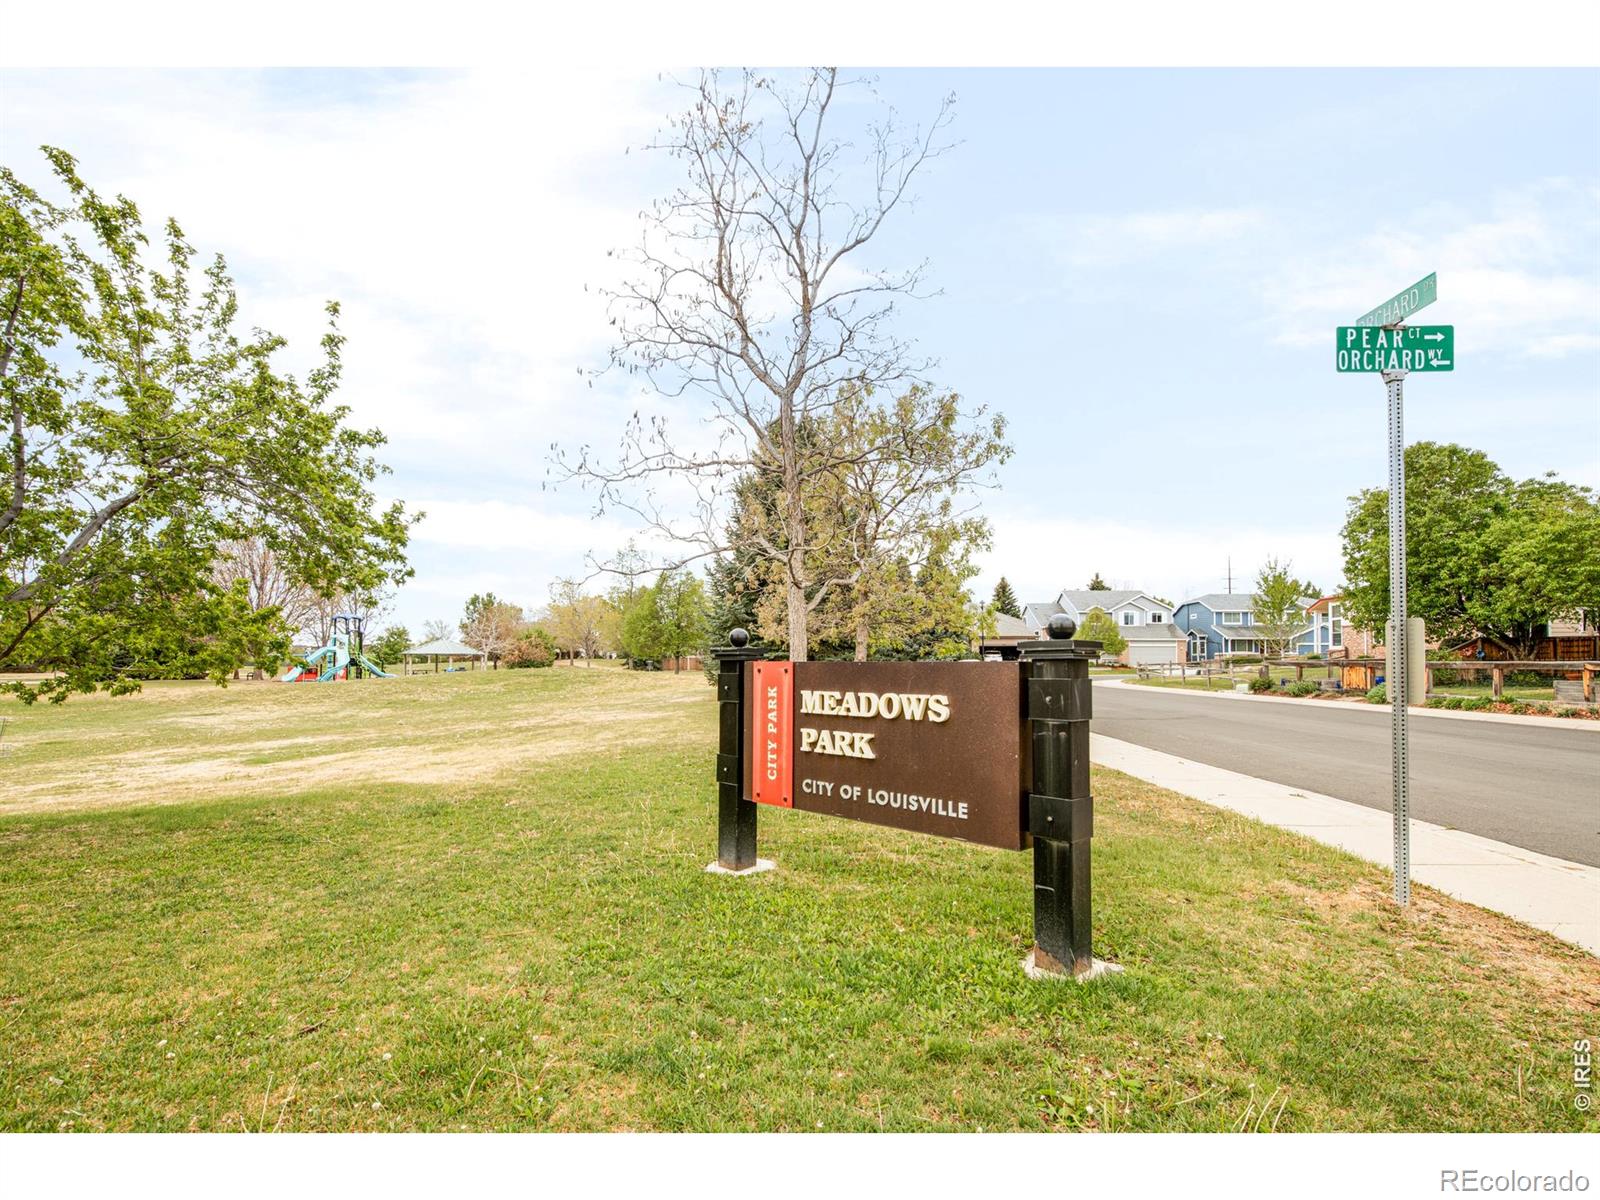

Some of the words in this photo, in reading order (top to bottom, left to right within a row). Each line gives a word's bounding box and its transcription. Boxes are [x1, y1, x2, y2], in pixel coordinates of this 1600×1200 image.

[1346, 328, 1403, 348] PEAR
[1408, 328, 1421, 339] CT
[1338, 349, 1425, 370] ORCHARD
[1427, 349, 1443, 359] WY
[767, 686, 778, 734] PARK
[800, 690, 951, 723] MEADOWS
[767, 741, 778, 780] CITY
[800, 728, 876, 760] PARK
[802, 778, 834, 797] CITY
[839, 784, 861, 801] OF
[867, 788, 969, 819] LOUISVILLE
